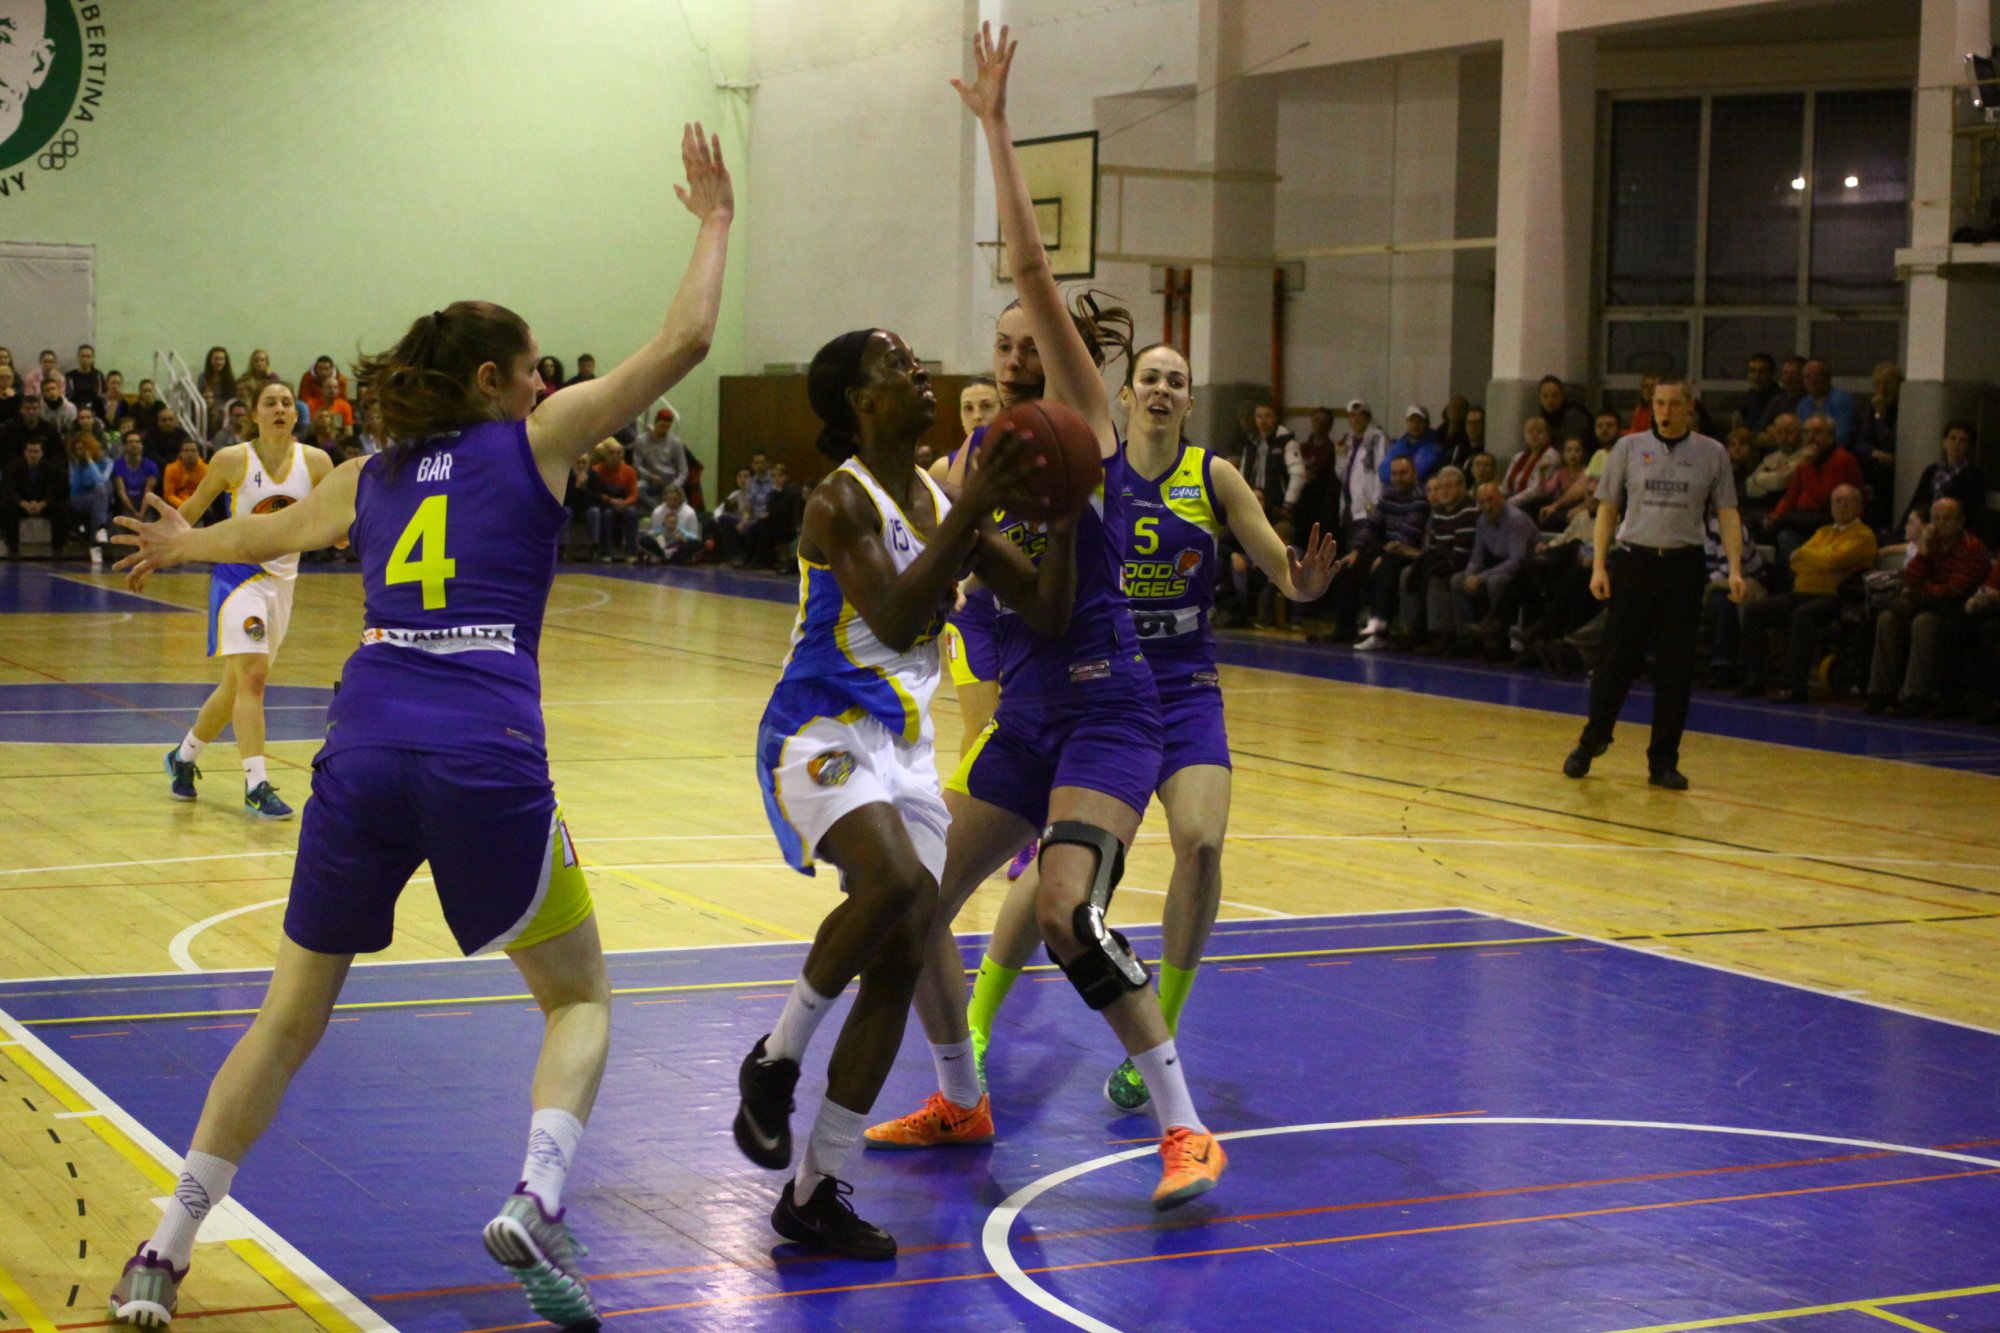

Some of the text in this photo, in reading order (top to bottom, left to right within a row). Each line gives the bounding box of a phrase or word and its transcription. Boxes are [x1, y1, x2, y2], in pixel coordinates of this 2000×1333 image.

[74, 0, 107, 122] BERTINA
[254, 471, 262, 488] 4
[416, 452, 453, 482] BÄR
[889, 518, 909, 551] 15
[1134, 516, 1159, 555] 5
[386, 494, 455, 610] 4
[1124, 563, 1174, 579] OOD
[1124, 579, 1187, 597] NGELS
